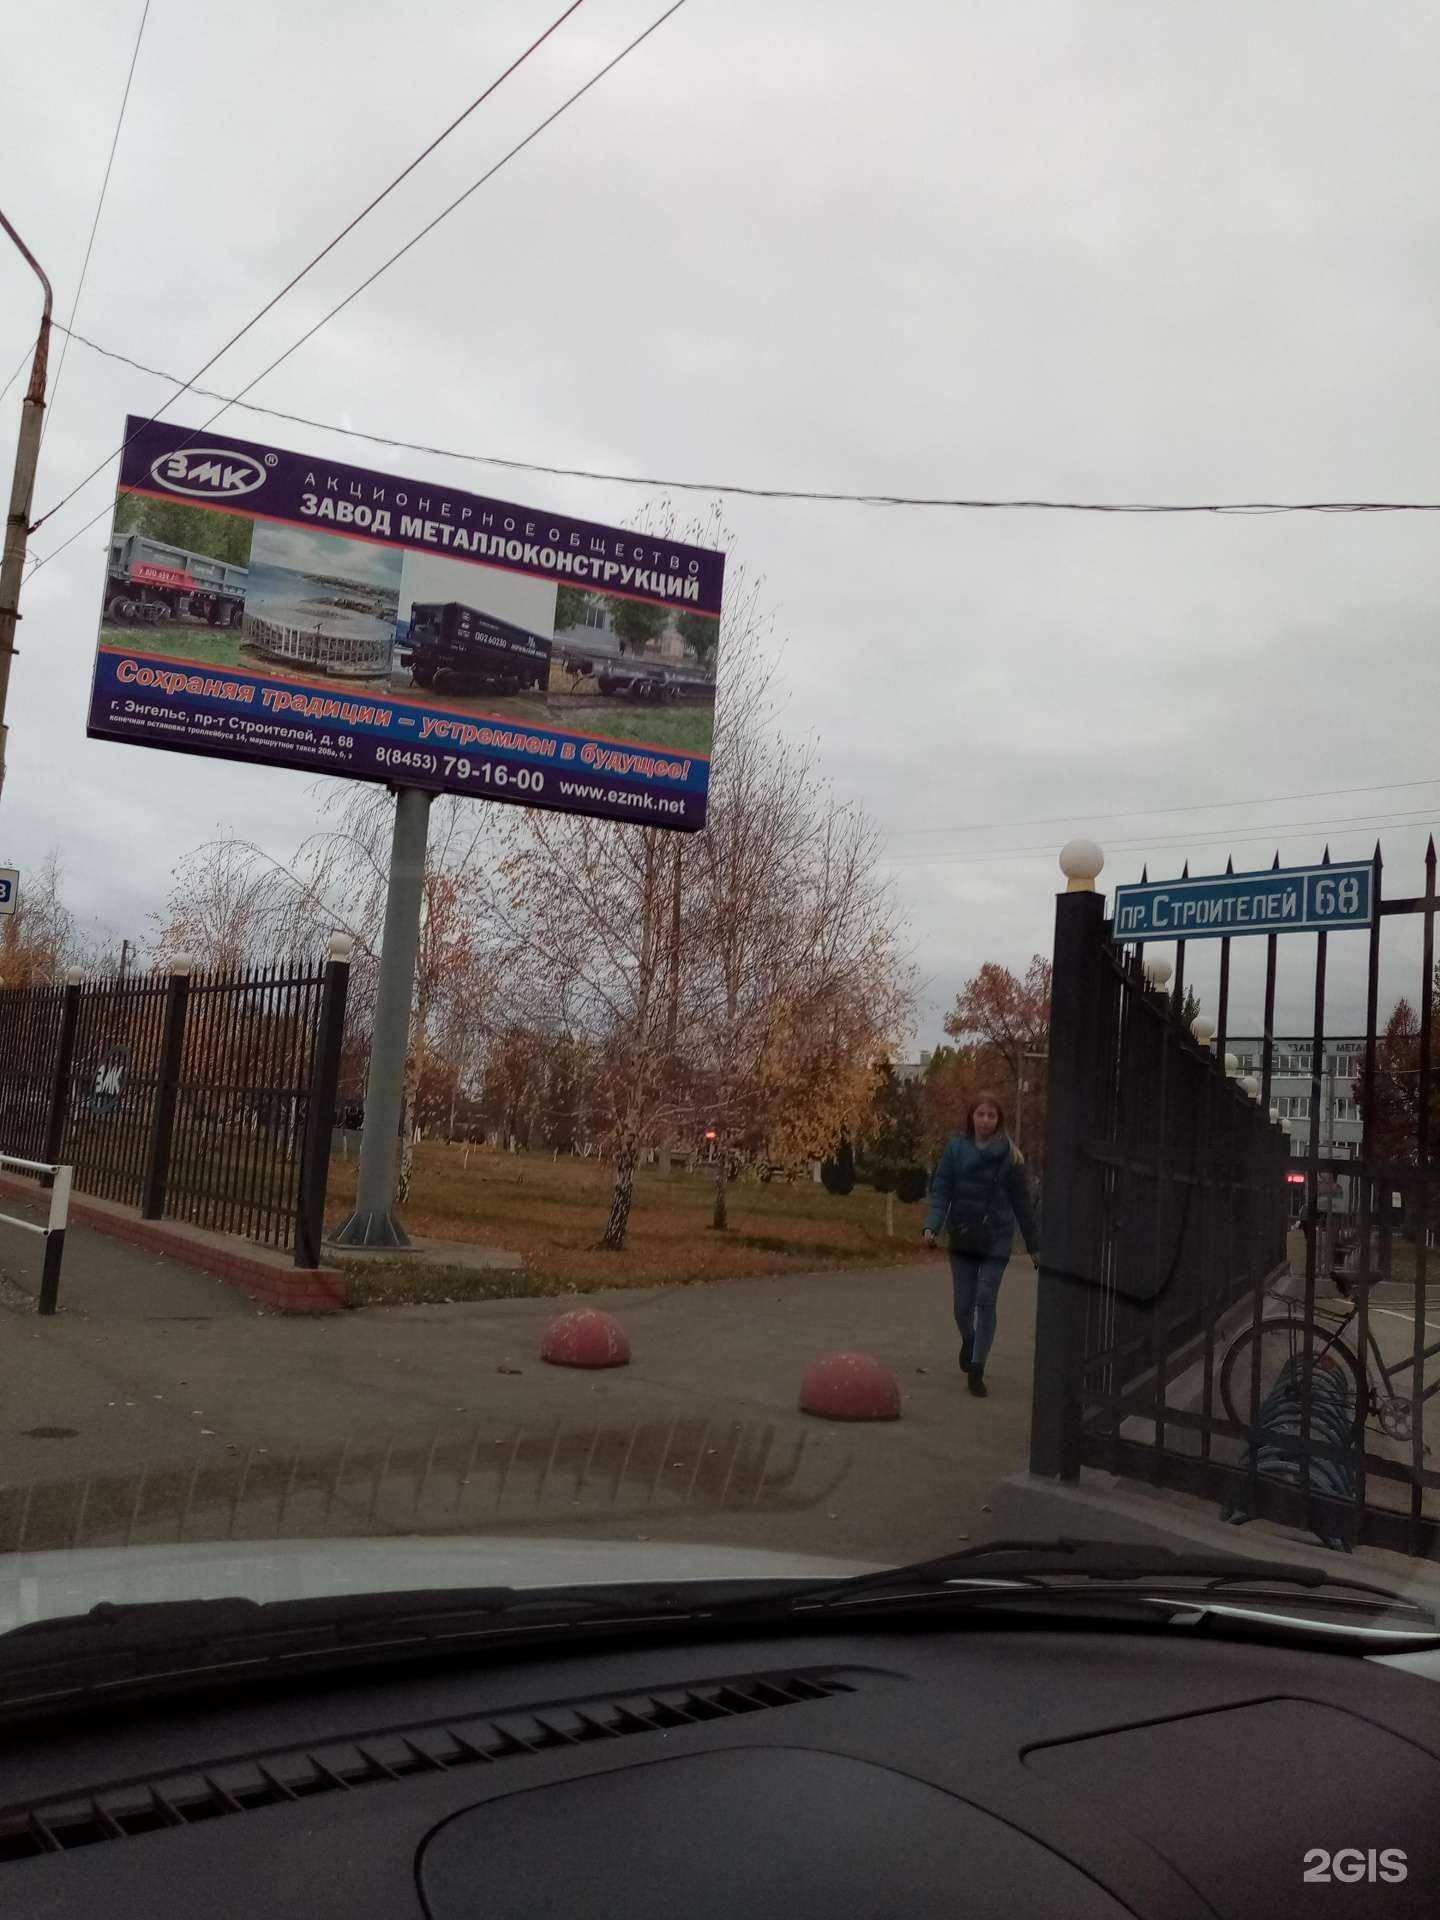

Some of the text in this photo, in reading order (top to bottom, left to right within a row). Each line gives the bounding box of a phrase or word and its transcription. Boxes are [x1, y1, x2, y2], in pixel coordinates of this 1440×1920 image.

[166, 453, 254, 489] ЗМК
[304, 472, 700, 575] АКЦИОНЕРНОЕ ОБЩЕСТВО
[300, 493, 700, 601] ЗАВОД МЕТАЛЛОКОНСТРУКЦИЙ
[110, 700, 354, 748] г. Энгельс, пр-т Строителей, д. 68
[116, 660, 255, 703] Сохраняя
[262, 687, 393, 727] традиции
[419, 715, 556, 757] устремлен
[560, 743, 577, 760] в
[580, 743, 692, 780] будущее!
[147, 720, 186, 732] остановка
[375, 747, 545, 793] 8(8453) 79-16-00
[559, 779, 687, 815] www.ezmk.net
[1314, 877, 1360, 916] 68
